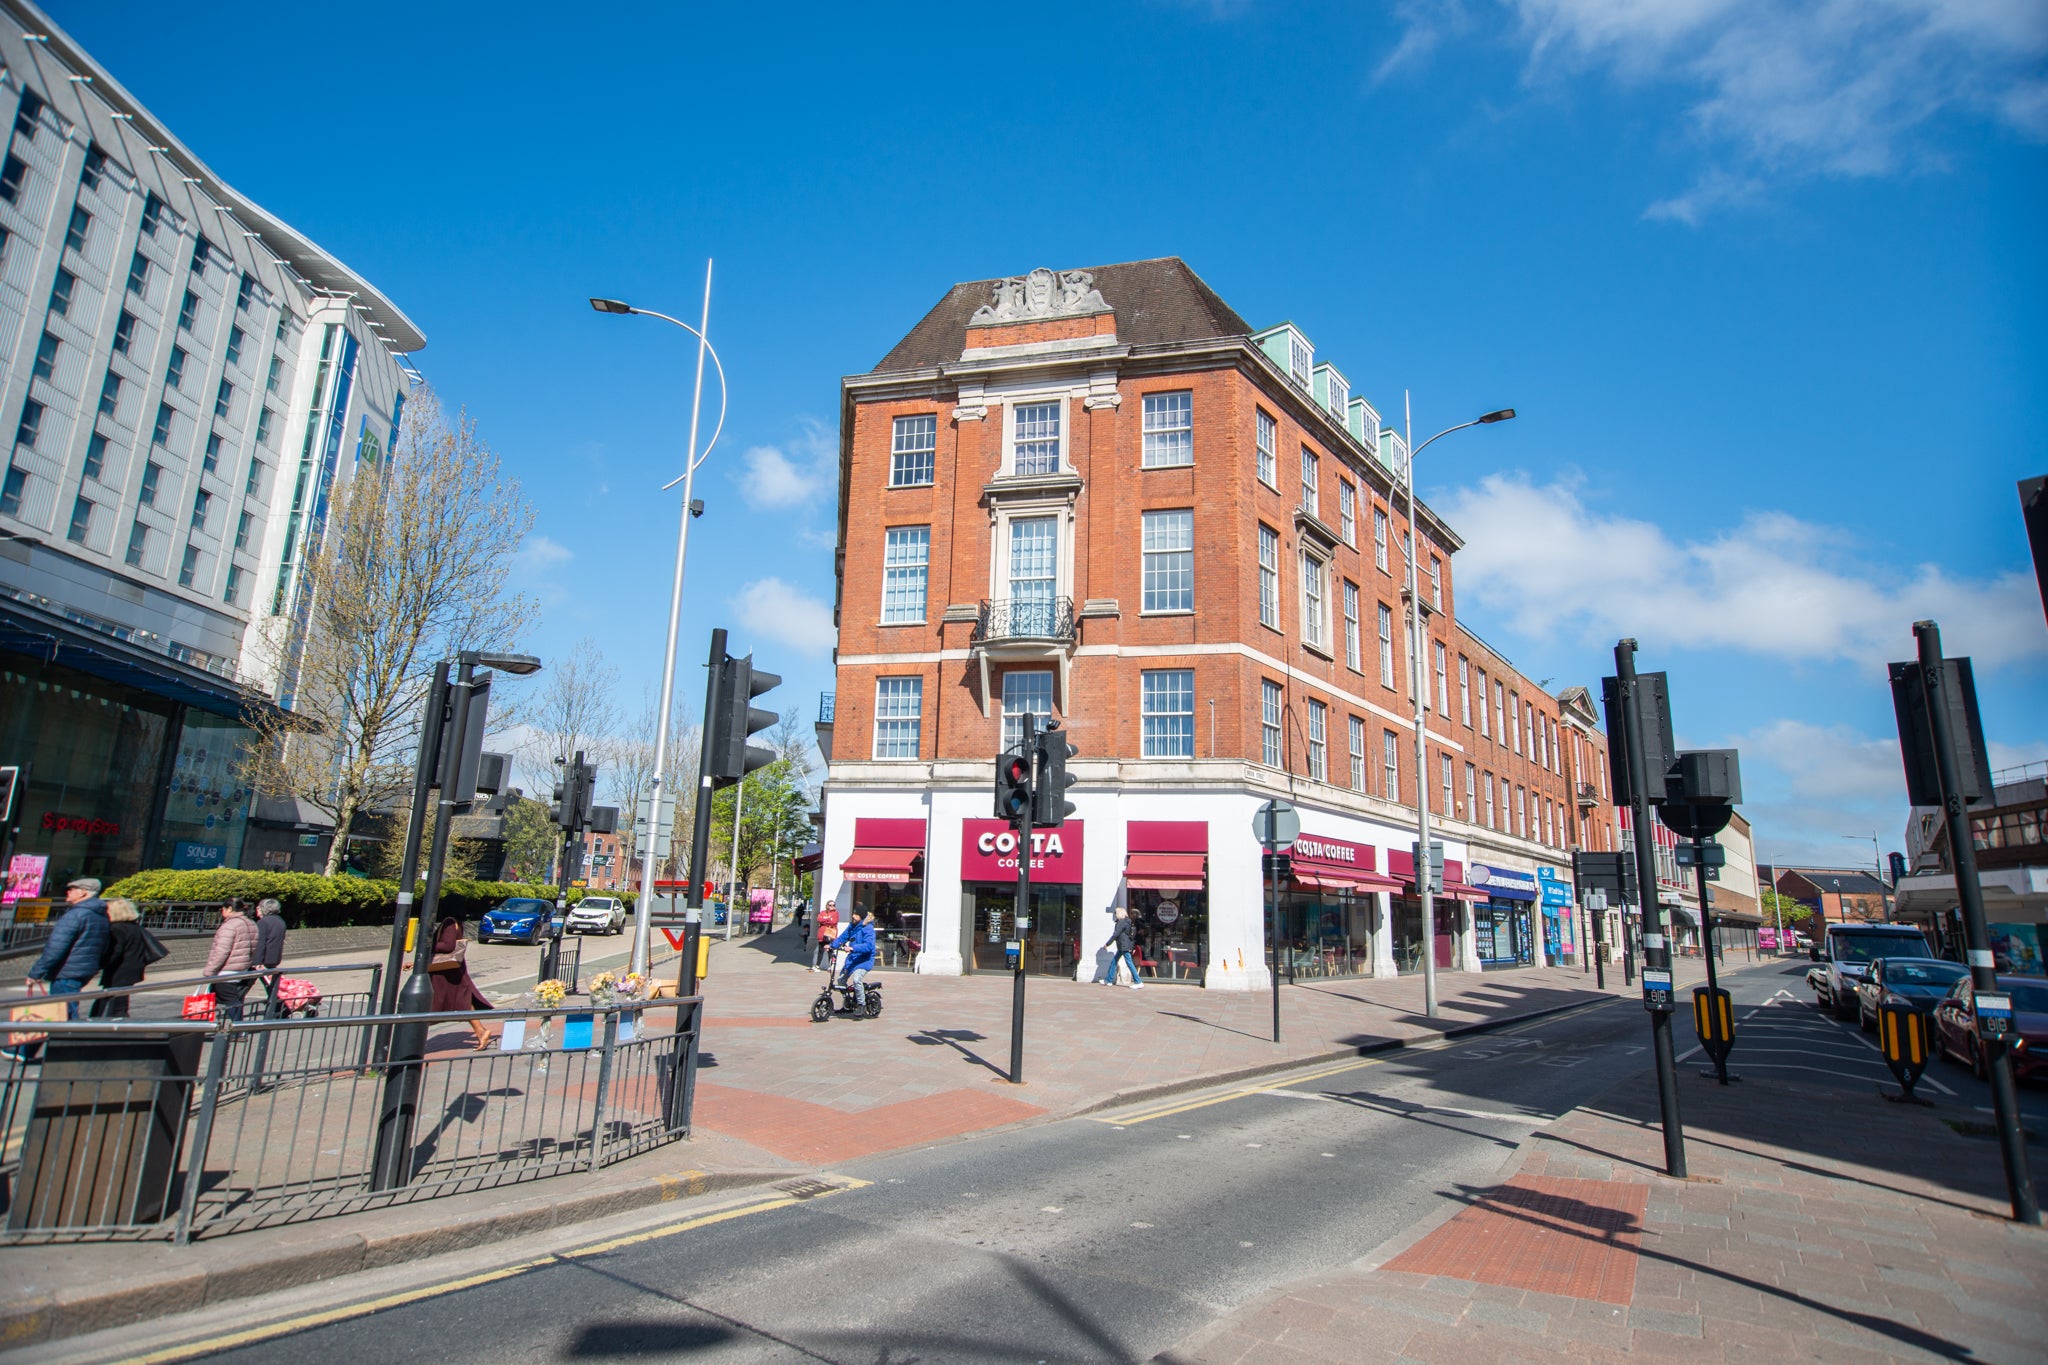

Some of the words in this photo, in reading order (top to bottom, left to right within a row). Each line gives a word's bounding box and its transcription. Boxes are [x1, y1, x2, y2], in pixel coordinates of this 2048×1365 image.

[979, 832, 1064, 853] COTA
[1296, 839, 1323, 857] COSTA
[1325, 844, 1355, 862] COFFEE
[998, 858, 1044, 868] COFEE
